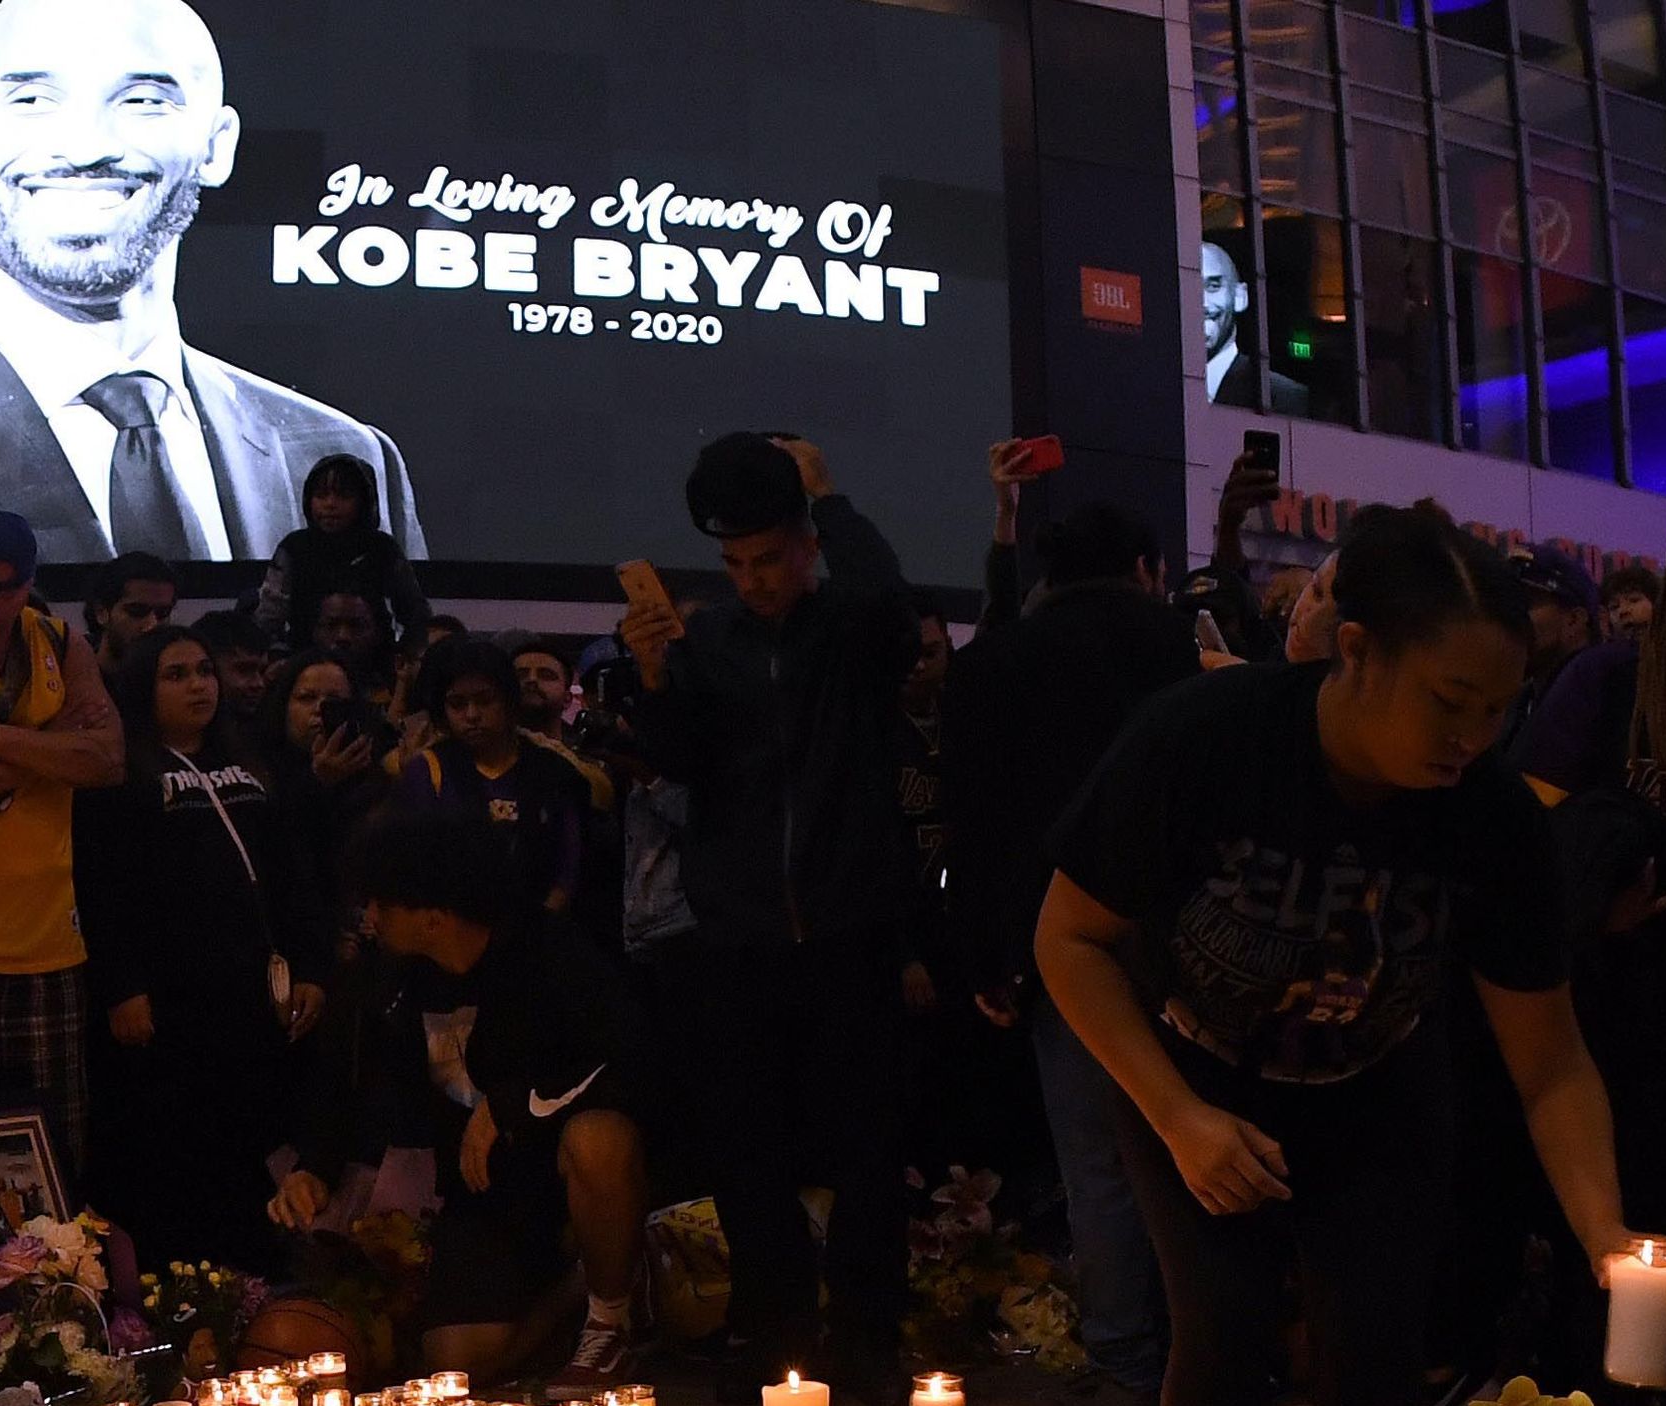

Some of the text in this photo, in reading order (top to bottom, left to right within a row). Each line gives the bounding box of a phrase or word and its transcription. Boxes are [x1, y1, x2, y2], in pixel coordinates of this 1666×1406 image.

[318, 163, 894, 258] In Loving Memory Of
[271, 224, 940, 327] KOBE BRYANT
[507, 302, 594, 336] 1978
[630, 310, 724, 346] 2020
